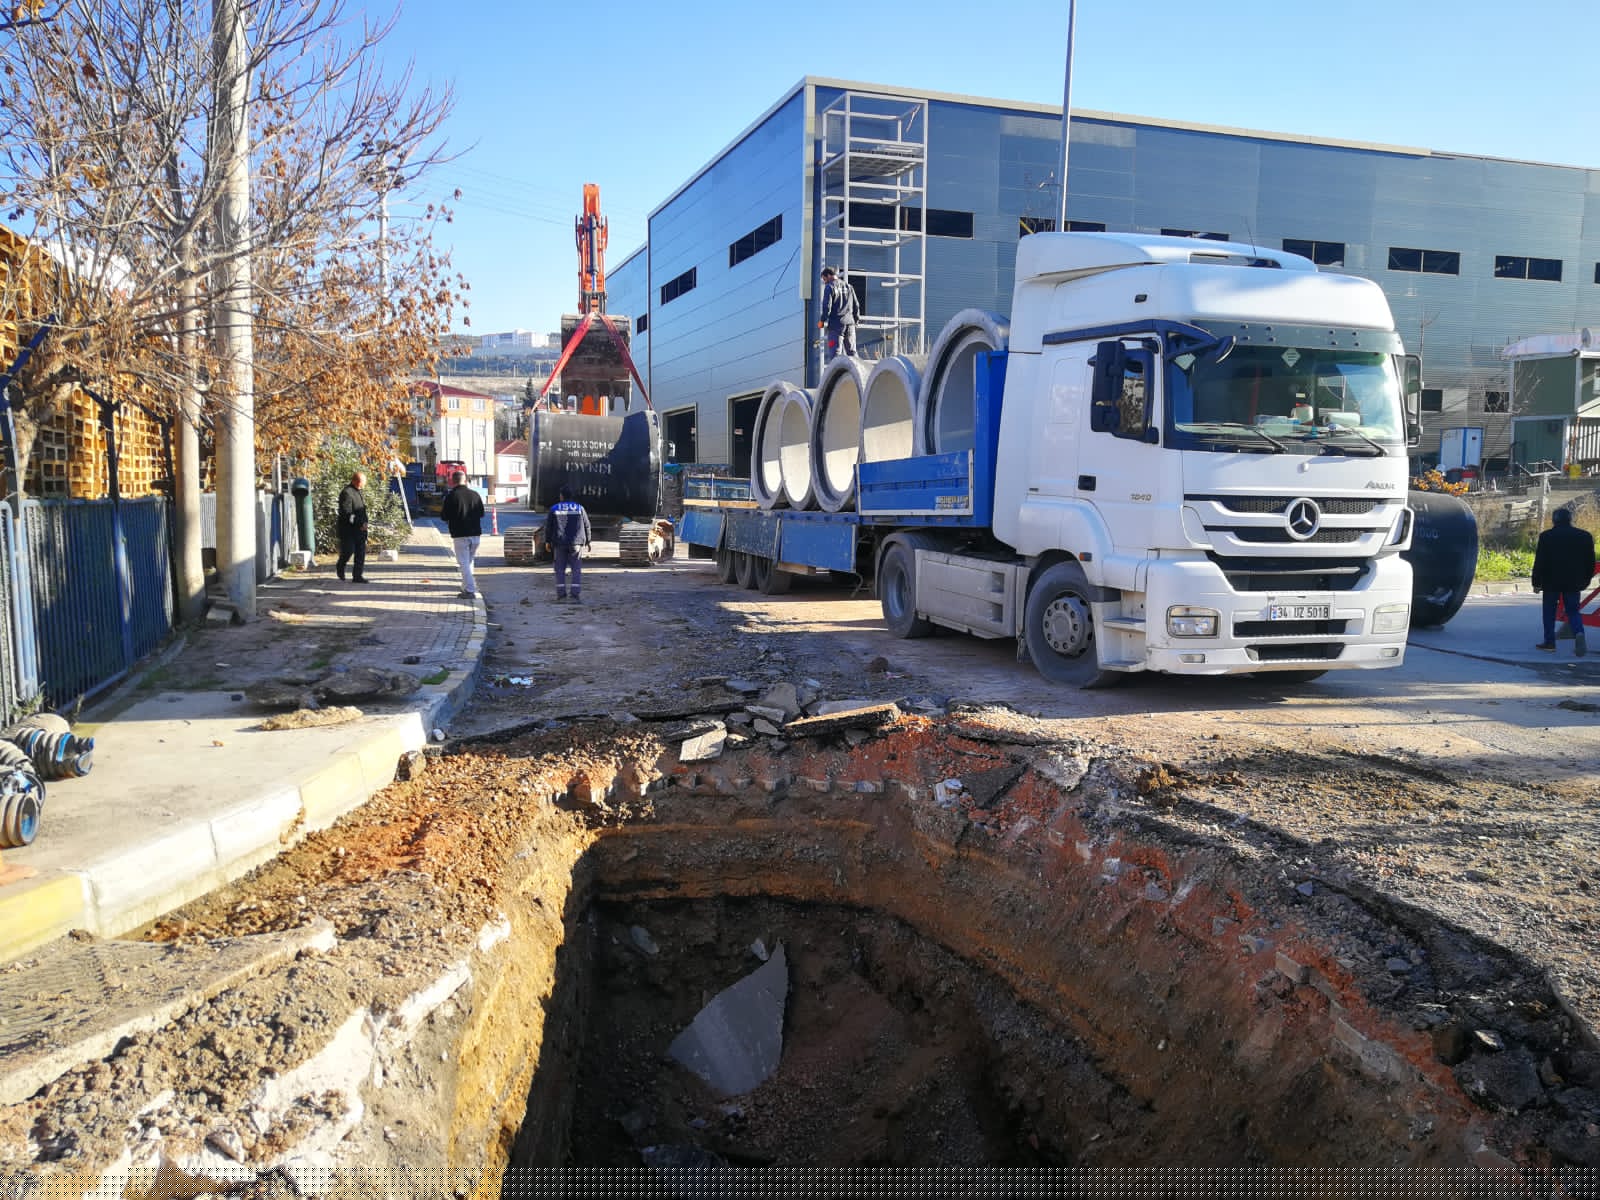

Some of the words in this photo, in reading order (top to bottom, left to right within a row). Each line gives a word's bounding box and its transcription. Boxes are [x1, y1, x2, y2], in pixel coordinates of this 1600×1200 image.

[1278, 607, 1288, 618] 34
[1294, 606, 1305, 618] UZ
[1307, 606, 1329, 618] 5018
